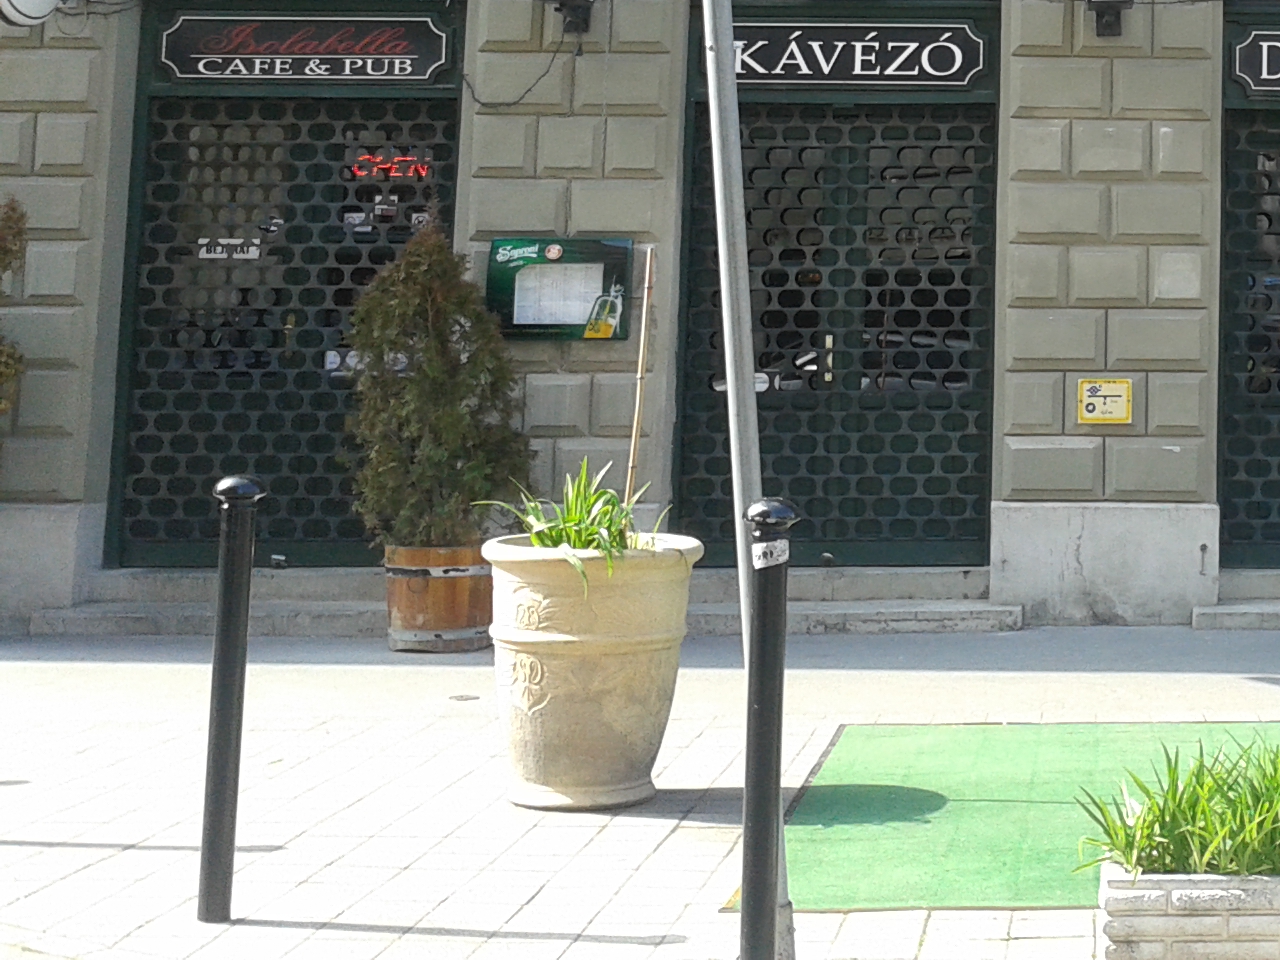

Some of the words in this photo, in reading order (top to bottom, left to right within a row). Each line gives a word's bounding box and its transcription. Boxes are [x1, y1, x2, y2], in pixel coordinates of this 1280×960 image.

[200, 22, 414, 55] Isolabella
[734, 30, 964, 77] KÁVÉZÓ
[197, 58, 293, 76] CAFE
[303, 58, 332, 76] &
[341, 58, 414, 76] PUB
